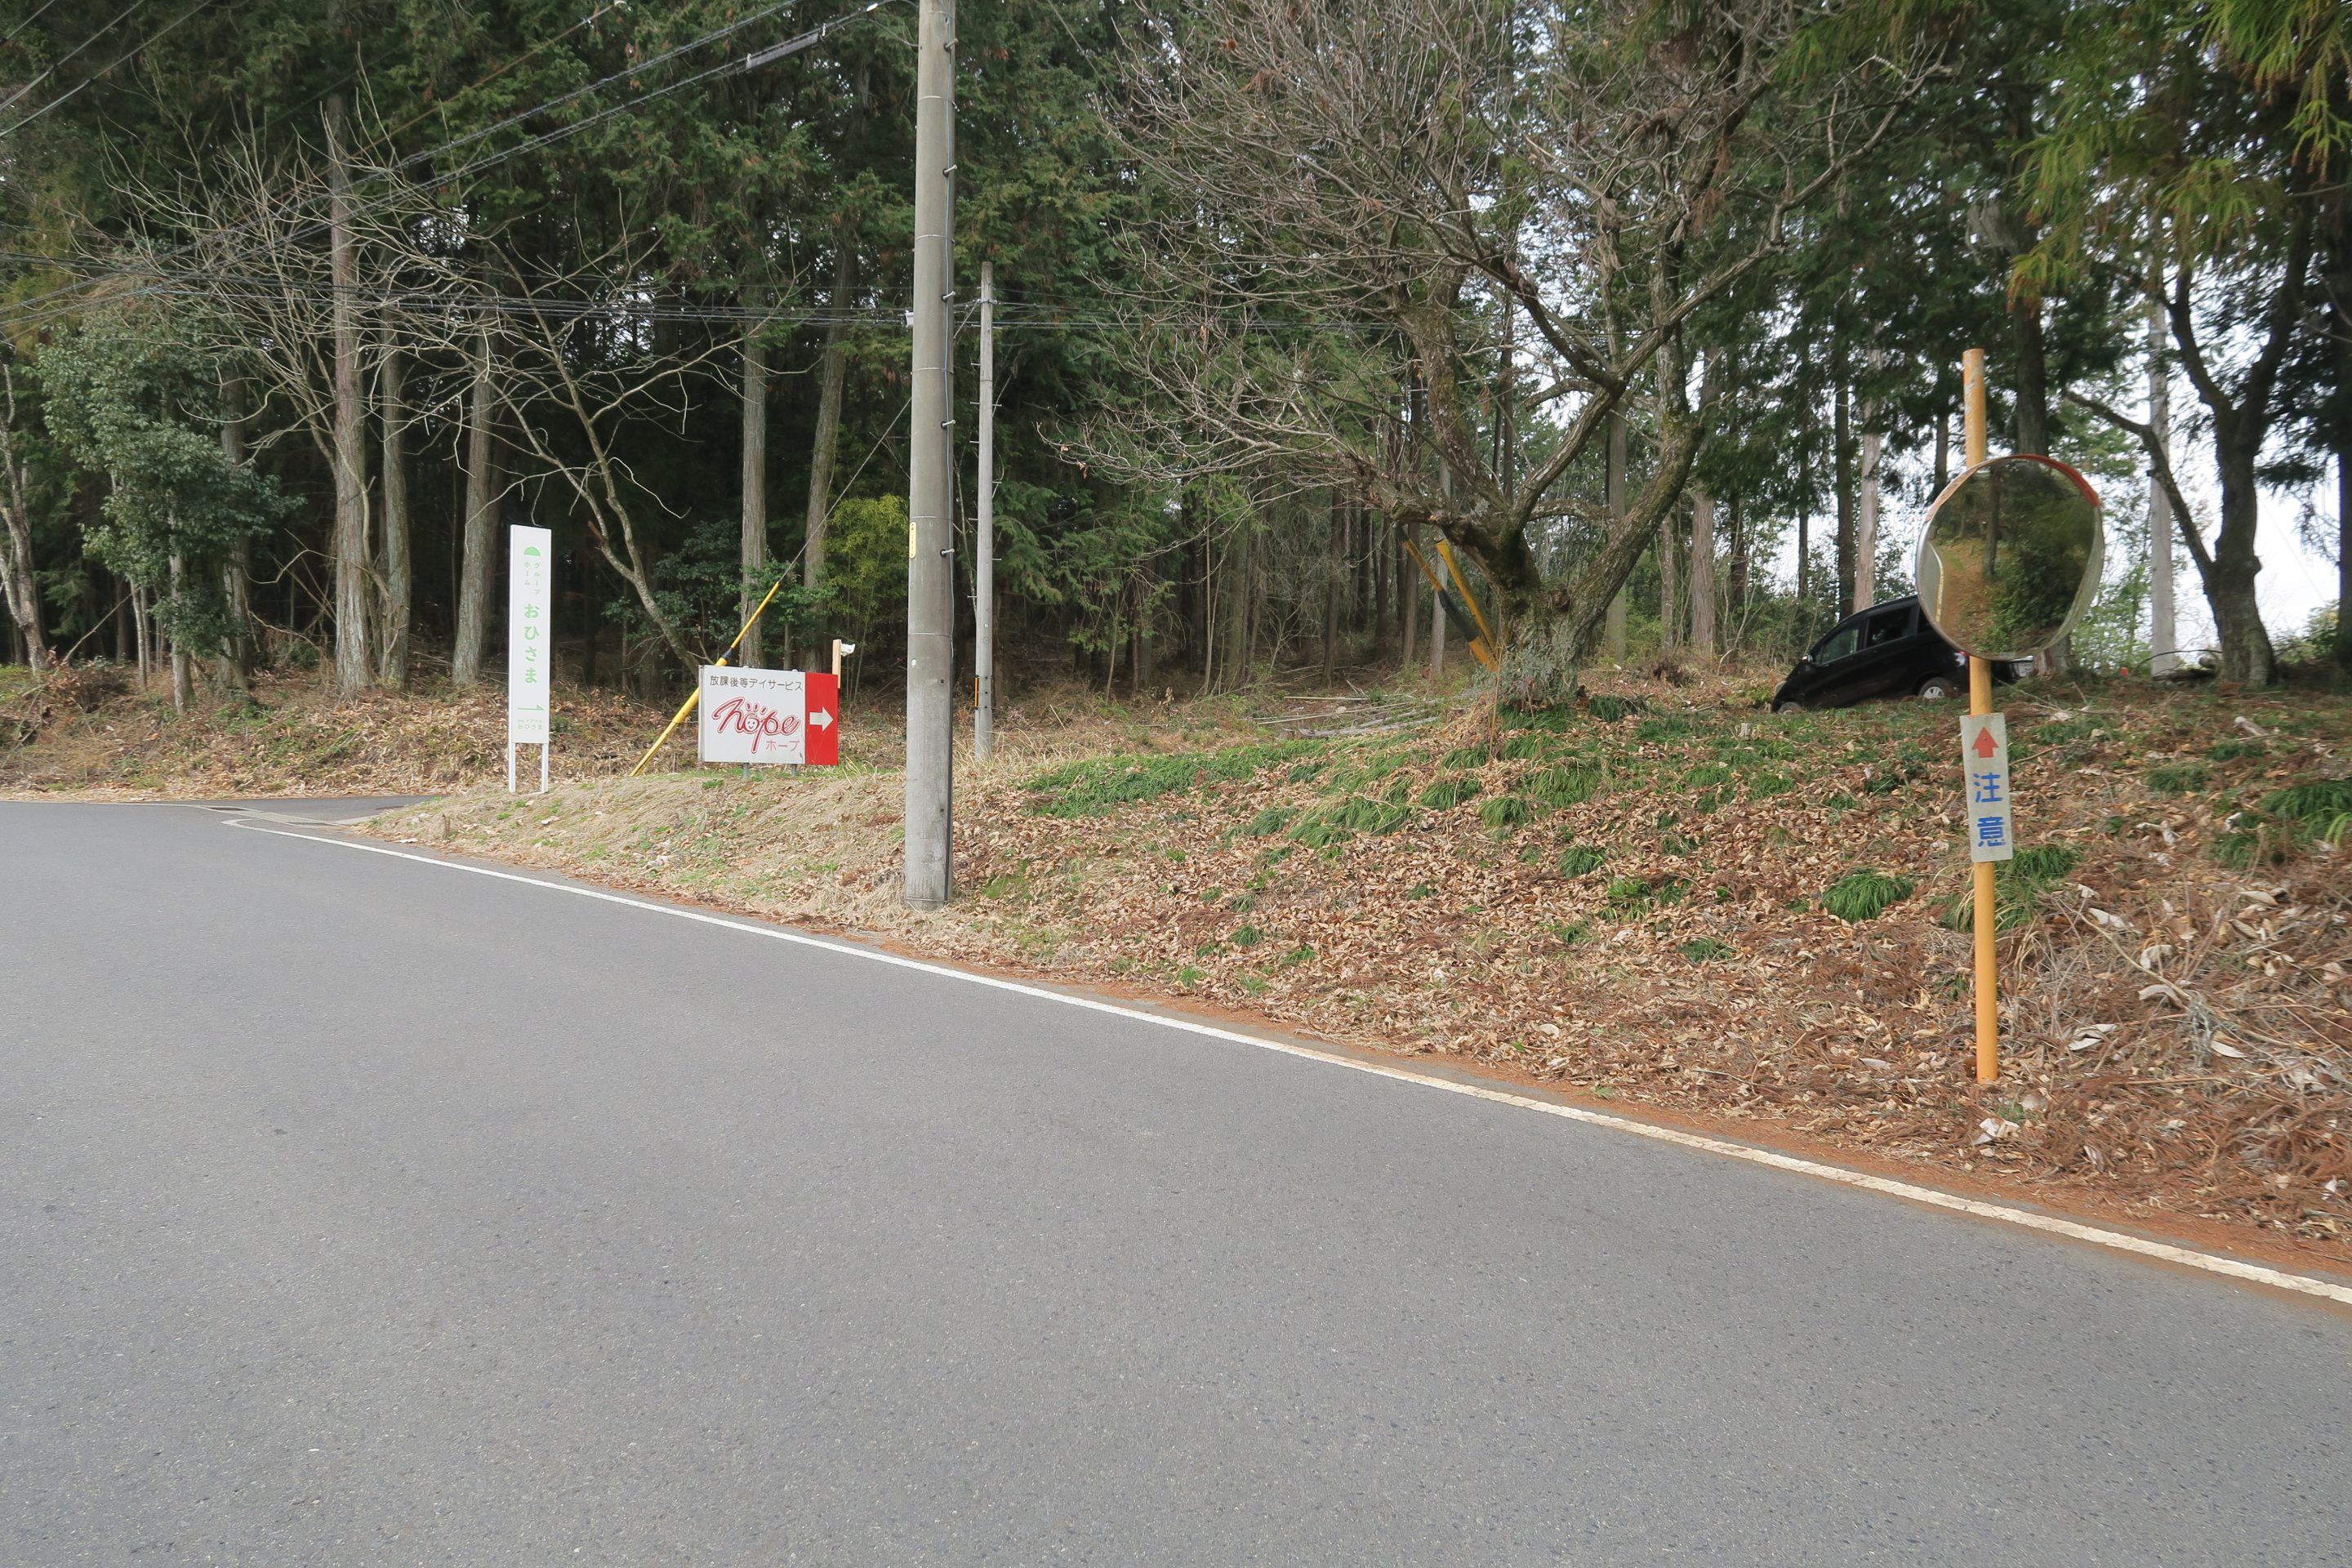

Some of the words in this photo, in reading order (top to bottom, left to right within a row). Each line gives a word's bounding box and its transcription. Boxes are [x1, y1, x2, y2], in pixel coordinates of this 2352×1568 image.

[523, 603, 540, 684] おひさま
[710, 675, 803, 692] 放課後等デイサービス
[1972, 772, 2006, 847] 注意
